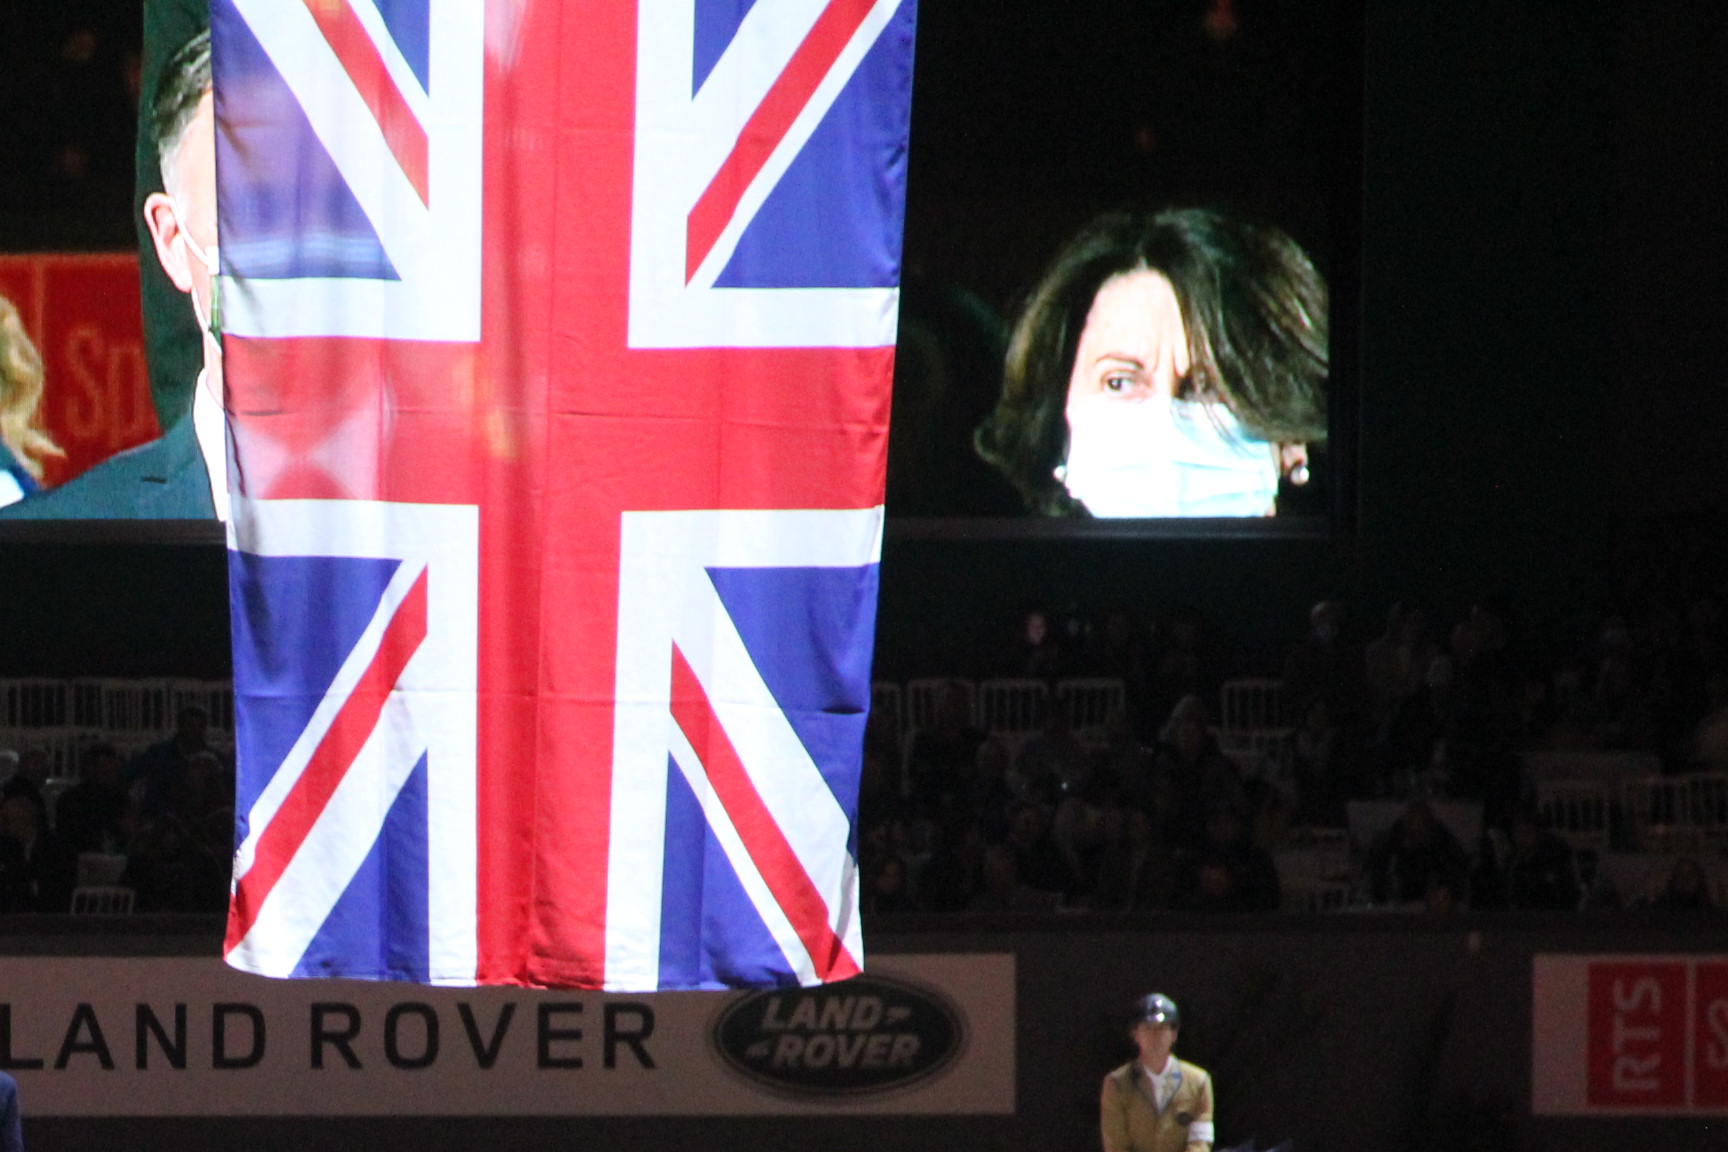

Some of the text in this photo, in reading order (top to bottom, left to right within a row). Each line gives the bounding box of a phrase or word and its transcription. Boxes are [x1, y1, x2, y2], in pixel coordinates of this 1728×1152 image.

[310, 1001, 657, 1071] ROVER
[762, 996, 883, 1030] LAND
[1612, 977, 1663, 1091] RTS
[772, 1033, 921, 1068] ROVER
